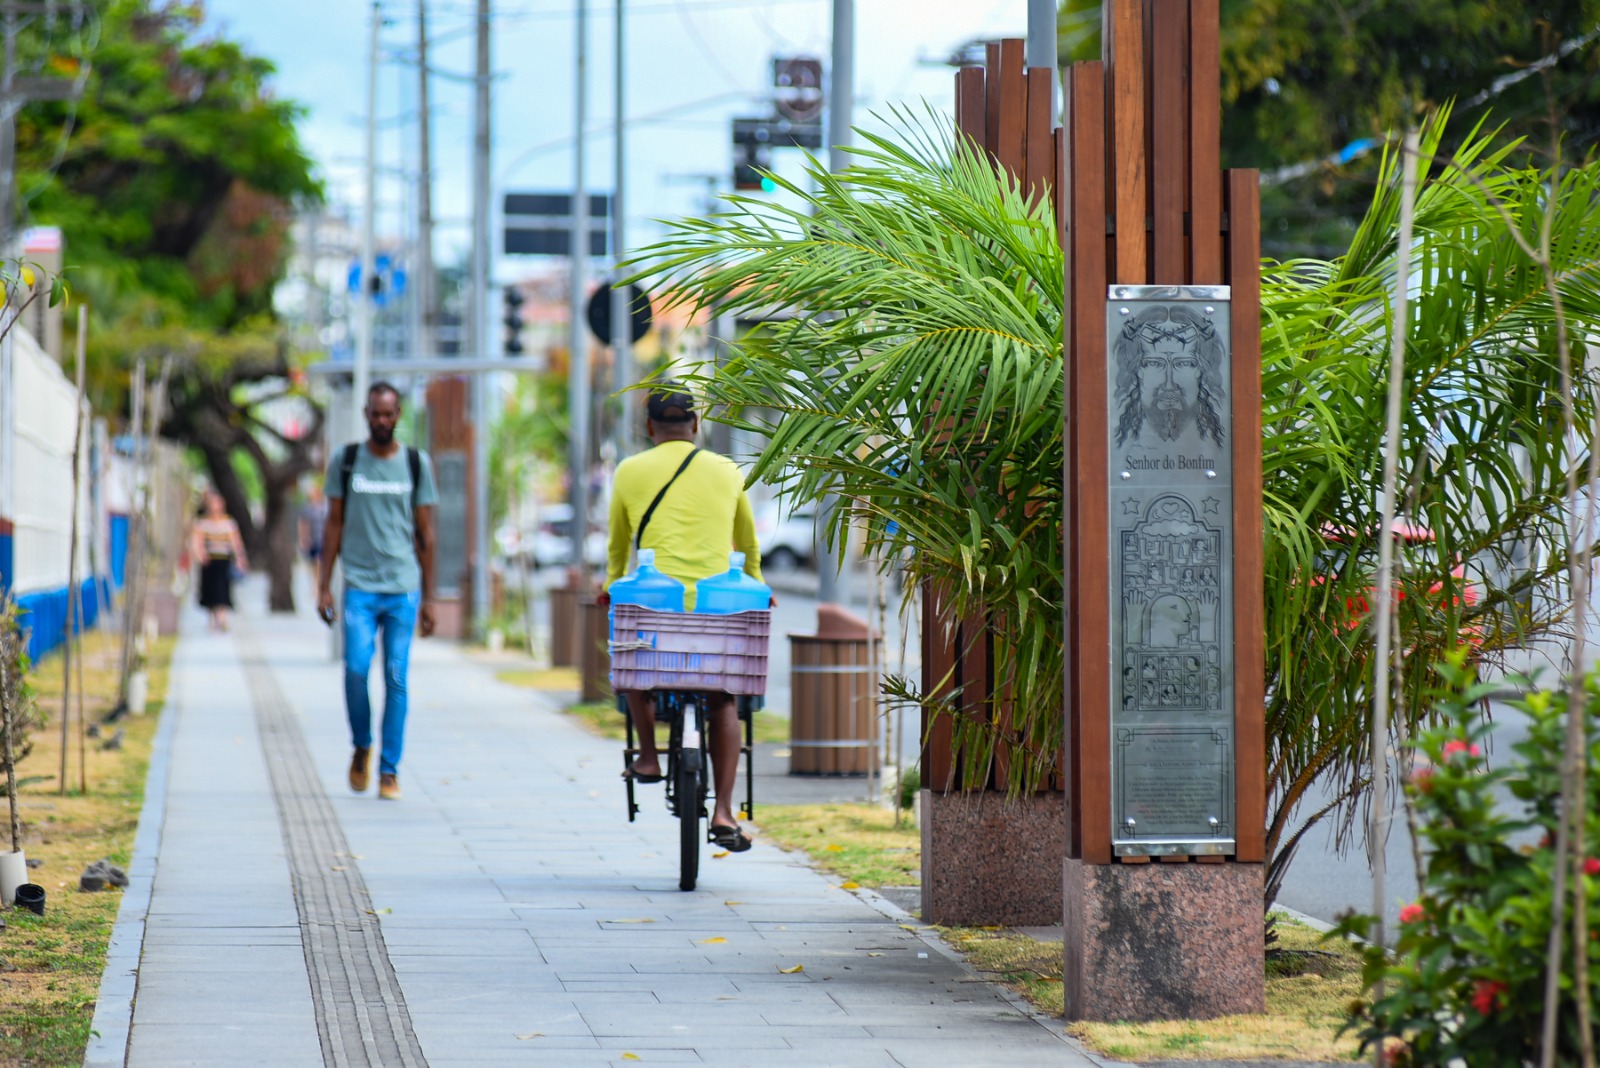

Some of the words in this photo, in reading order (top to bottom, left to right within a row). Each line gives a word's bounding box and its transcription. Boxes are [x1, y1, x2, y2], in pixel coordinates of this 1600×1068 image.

[1126, 455, 1160, 470] Senhor
[1163, 455, 1175, 470] do
[1178, 455, 1215, 470] Bonfim
